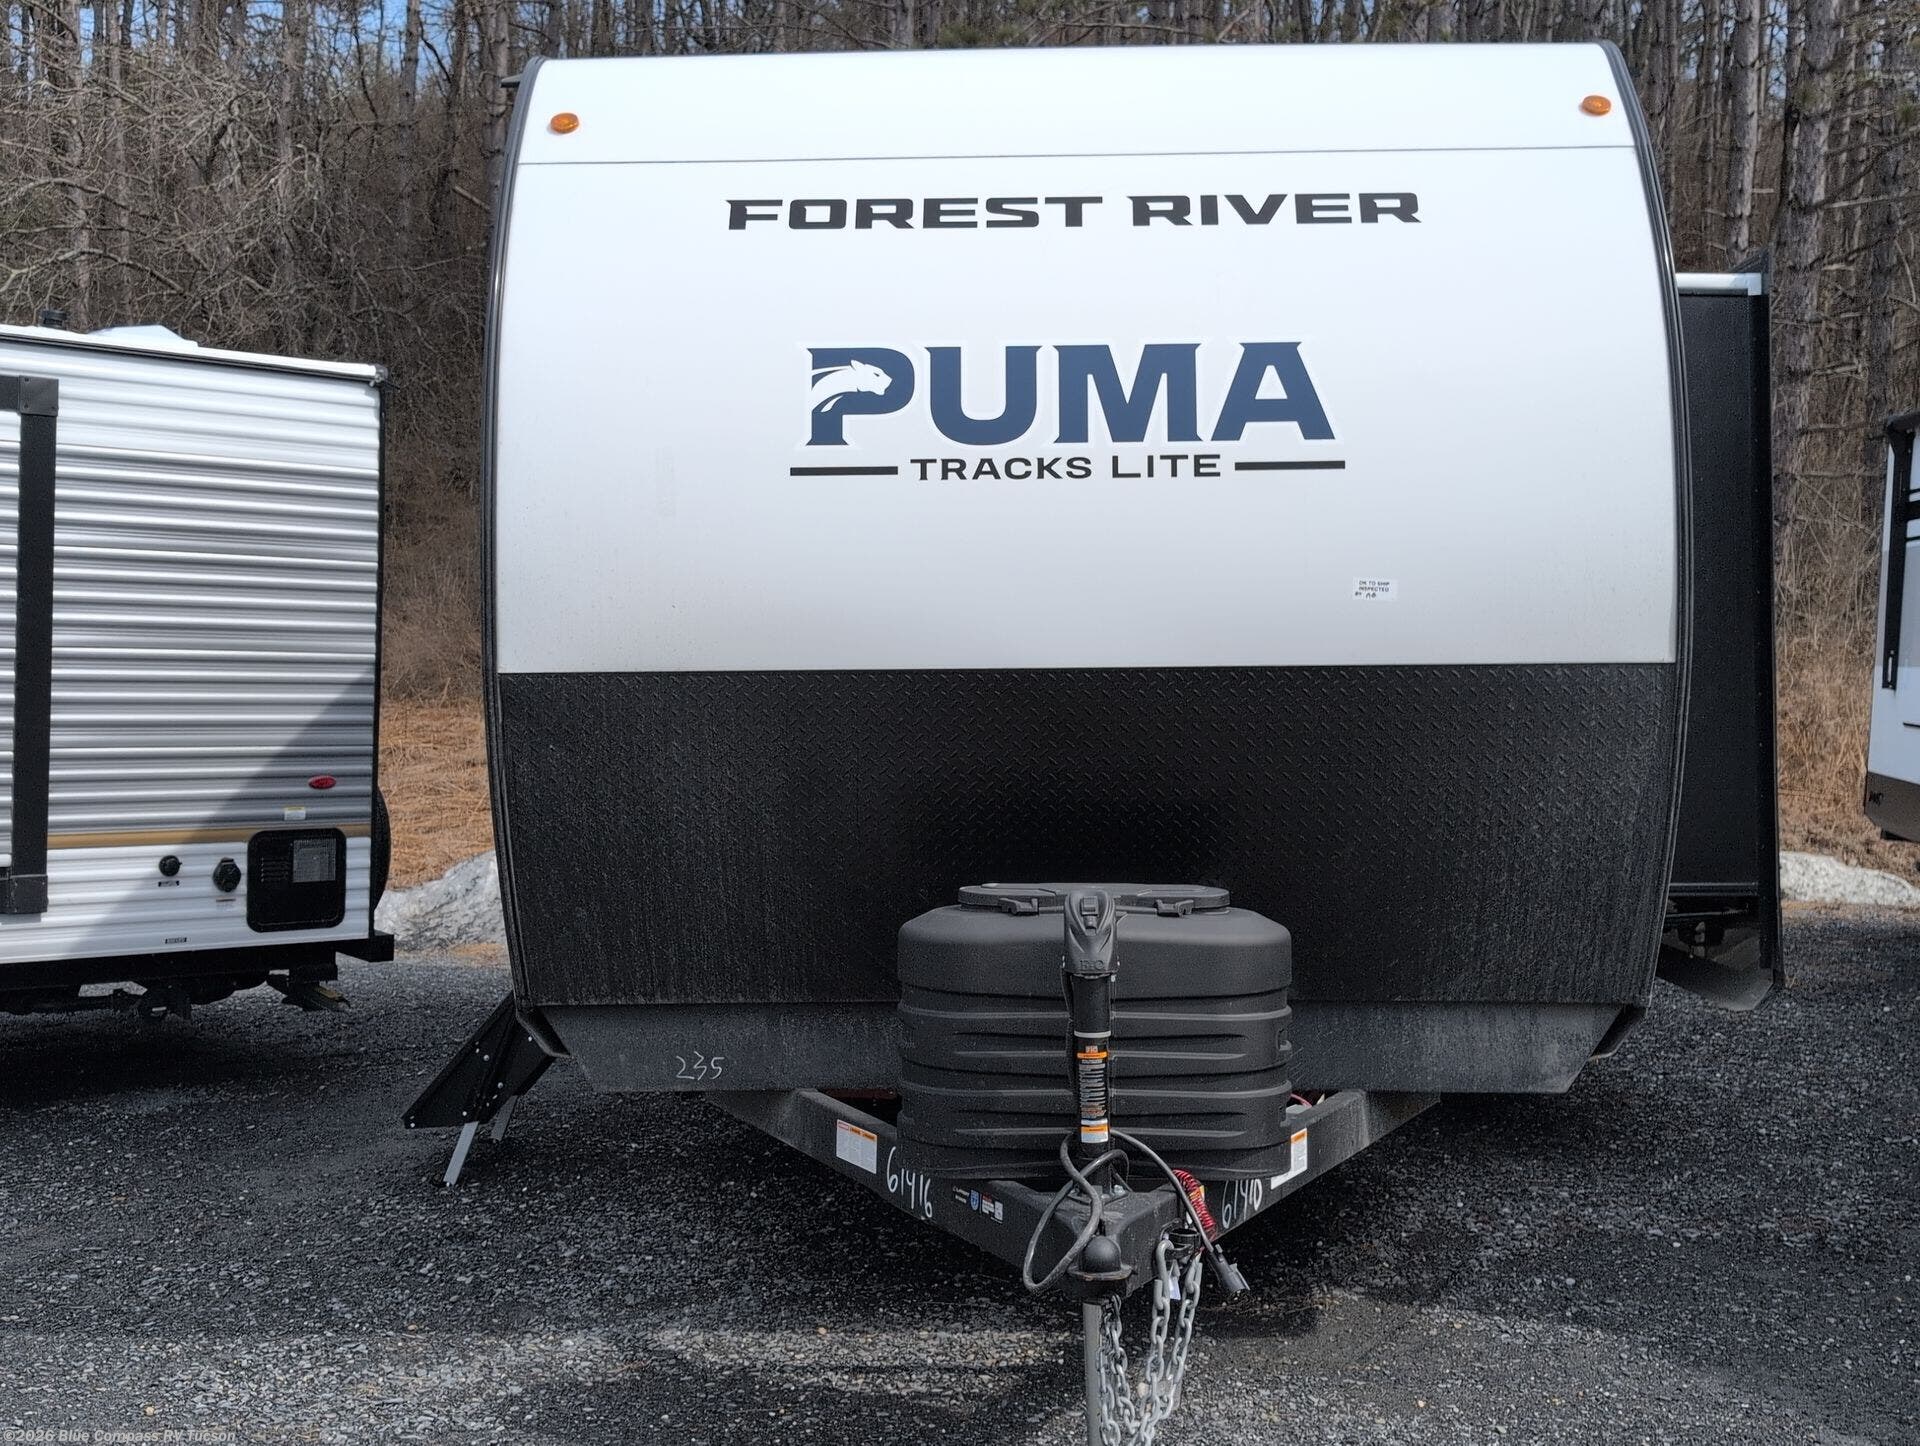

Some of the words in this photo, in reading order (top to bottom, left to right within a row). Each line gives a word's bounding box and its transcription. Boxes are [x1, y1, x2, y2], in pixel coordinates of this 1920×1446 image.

[726, 196, 1103, 230] FOREST
[1127, 192, 1422, 226] RIVER
[805, 342, 1336, 446] PUMA
[910, 457, 1092, 481] TRACKS
[1112, 454, 1221, 478] LITE
[676, 1050, 725, 1081] 235
[886, 1146, 933, 1218] 61416
